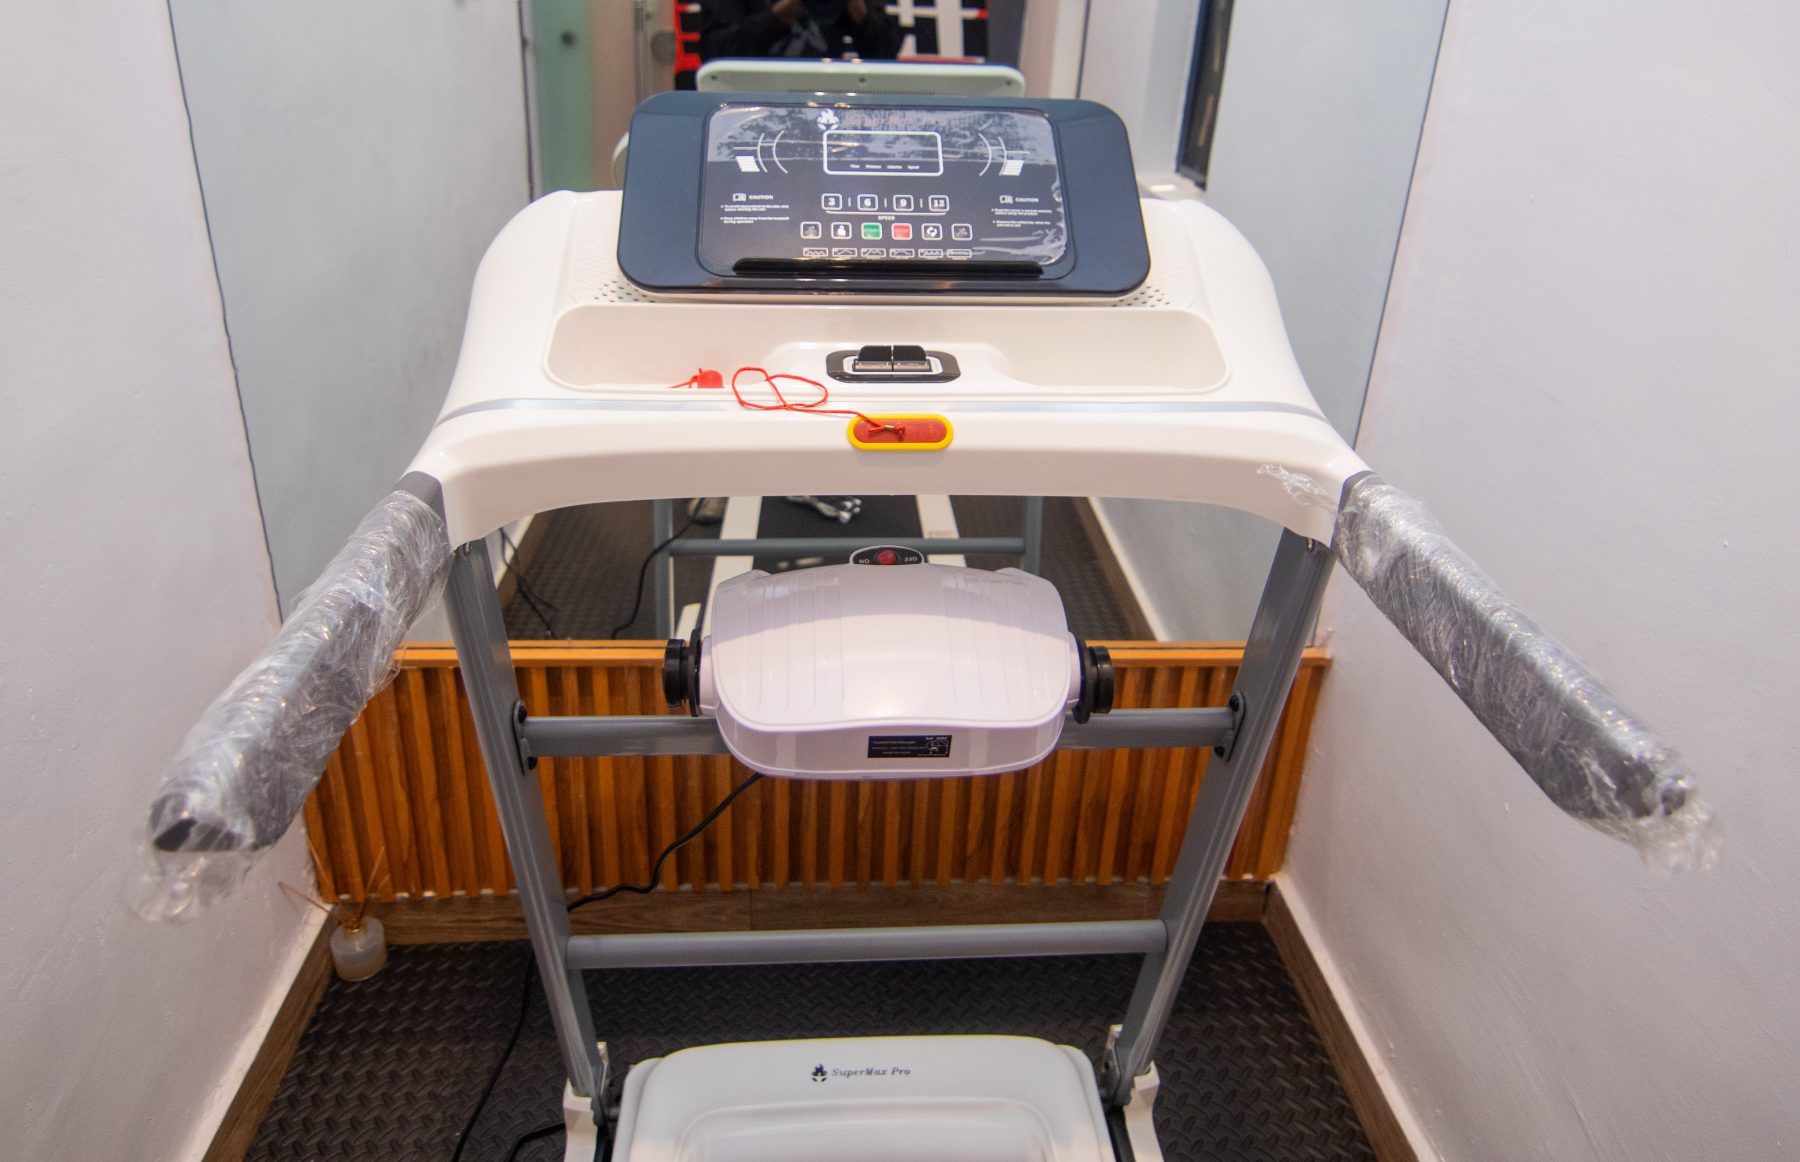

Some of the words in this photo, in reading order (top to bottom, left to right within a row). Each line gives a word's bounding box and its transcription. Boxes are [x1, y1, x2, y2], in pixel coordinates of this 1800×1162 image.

[828, 198, 836, 206] 3
[864, 198, 872, 207] 6
[899, 199, 907, 207] 9
[933, 199, 946, 208] 12
[831, 1067, 888, 1078] SuperMax
[891, 1066, 911, 1076] Pro
